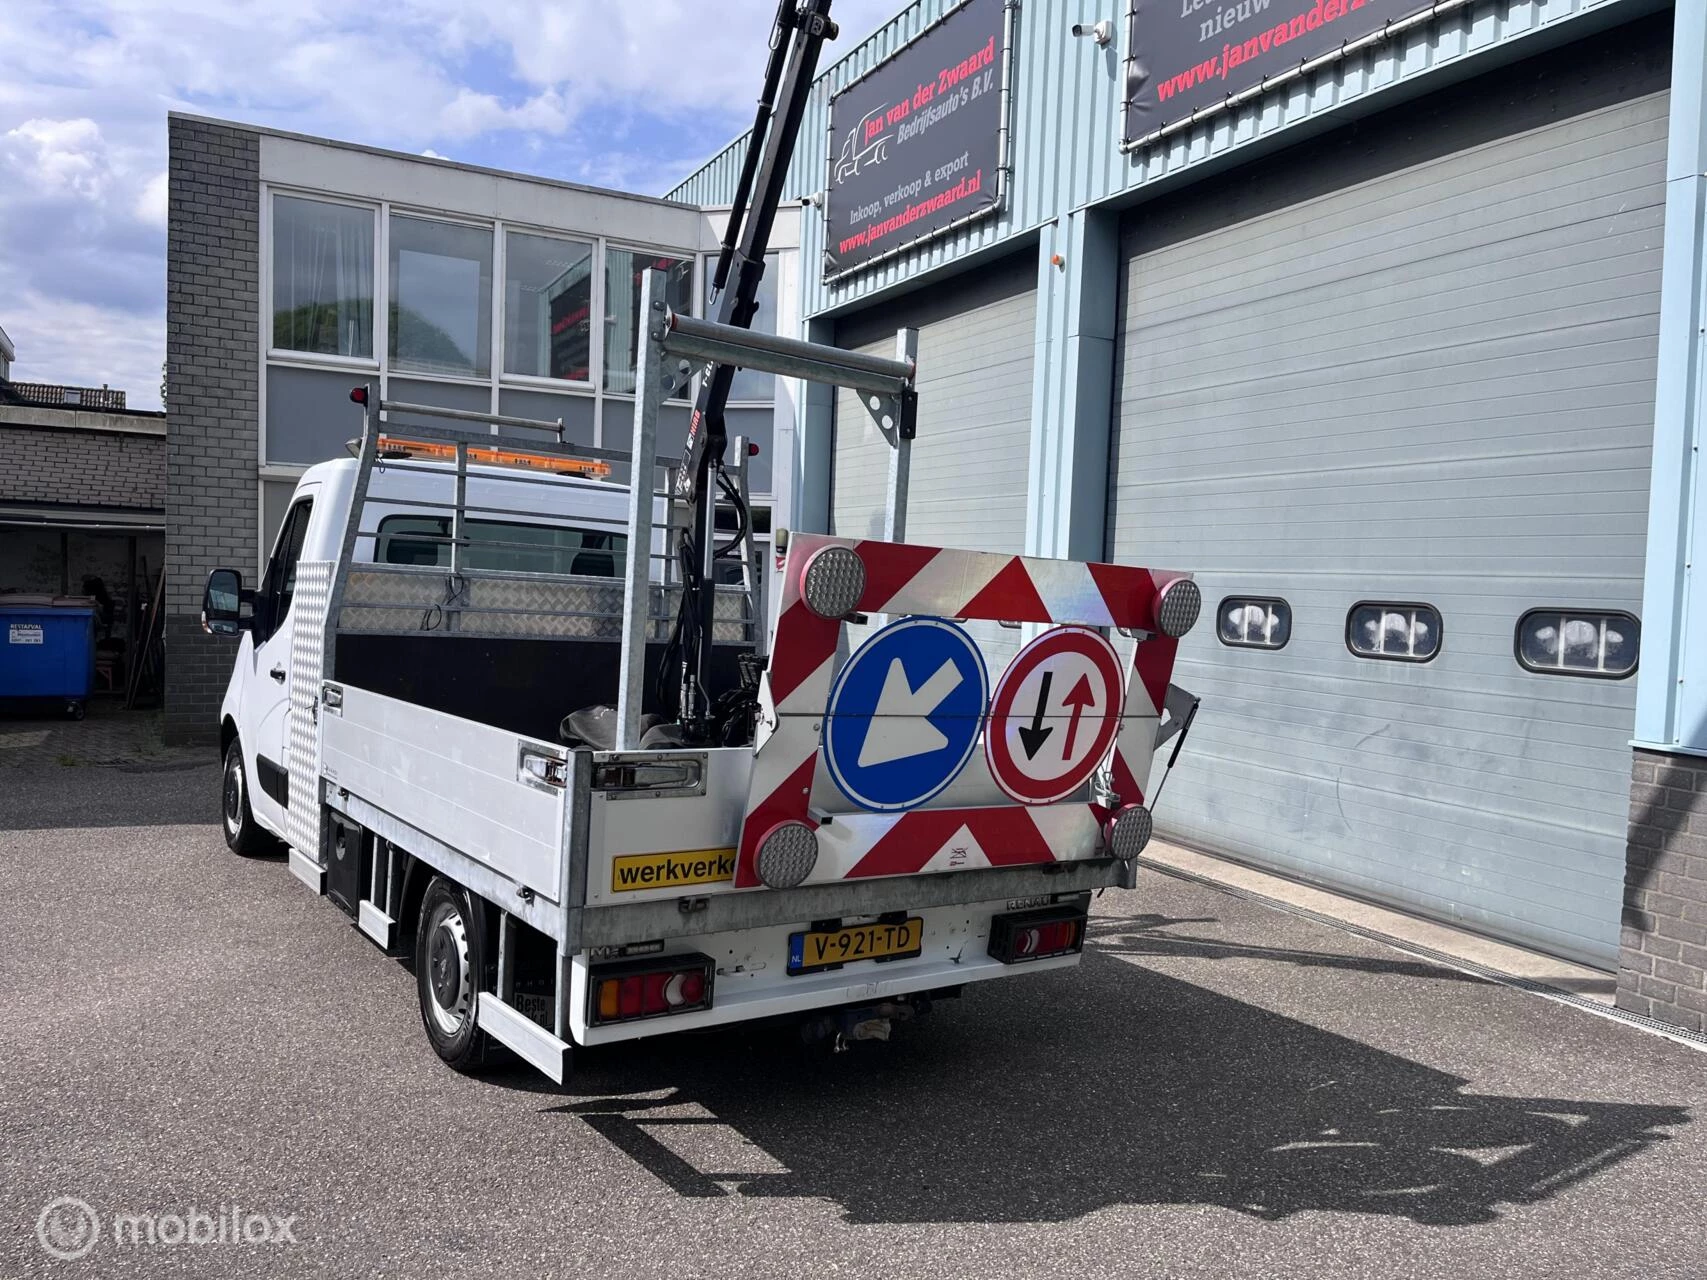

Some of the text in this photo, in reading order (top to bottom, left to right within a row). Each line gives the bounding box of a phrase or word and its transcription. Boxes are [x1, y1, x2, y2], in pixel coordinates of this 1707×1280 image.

[864, 36, 995, 146] Jan van der Zwaard
[897, 68, 994, 145] Bedrijfsauto's B.V.
[839, 169, 982, 255] www.janvanderzwaard.nl
[850, 151, 969, 225] Inkoop, verkoop & export
[1006, 895, 1050, 911] RENAU
[791, 926, 910, 963] NL V-921-TD
